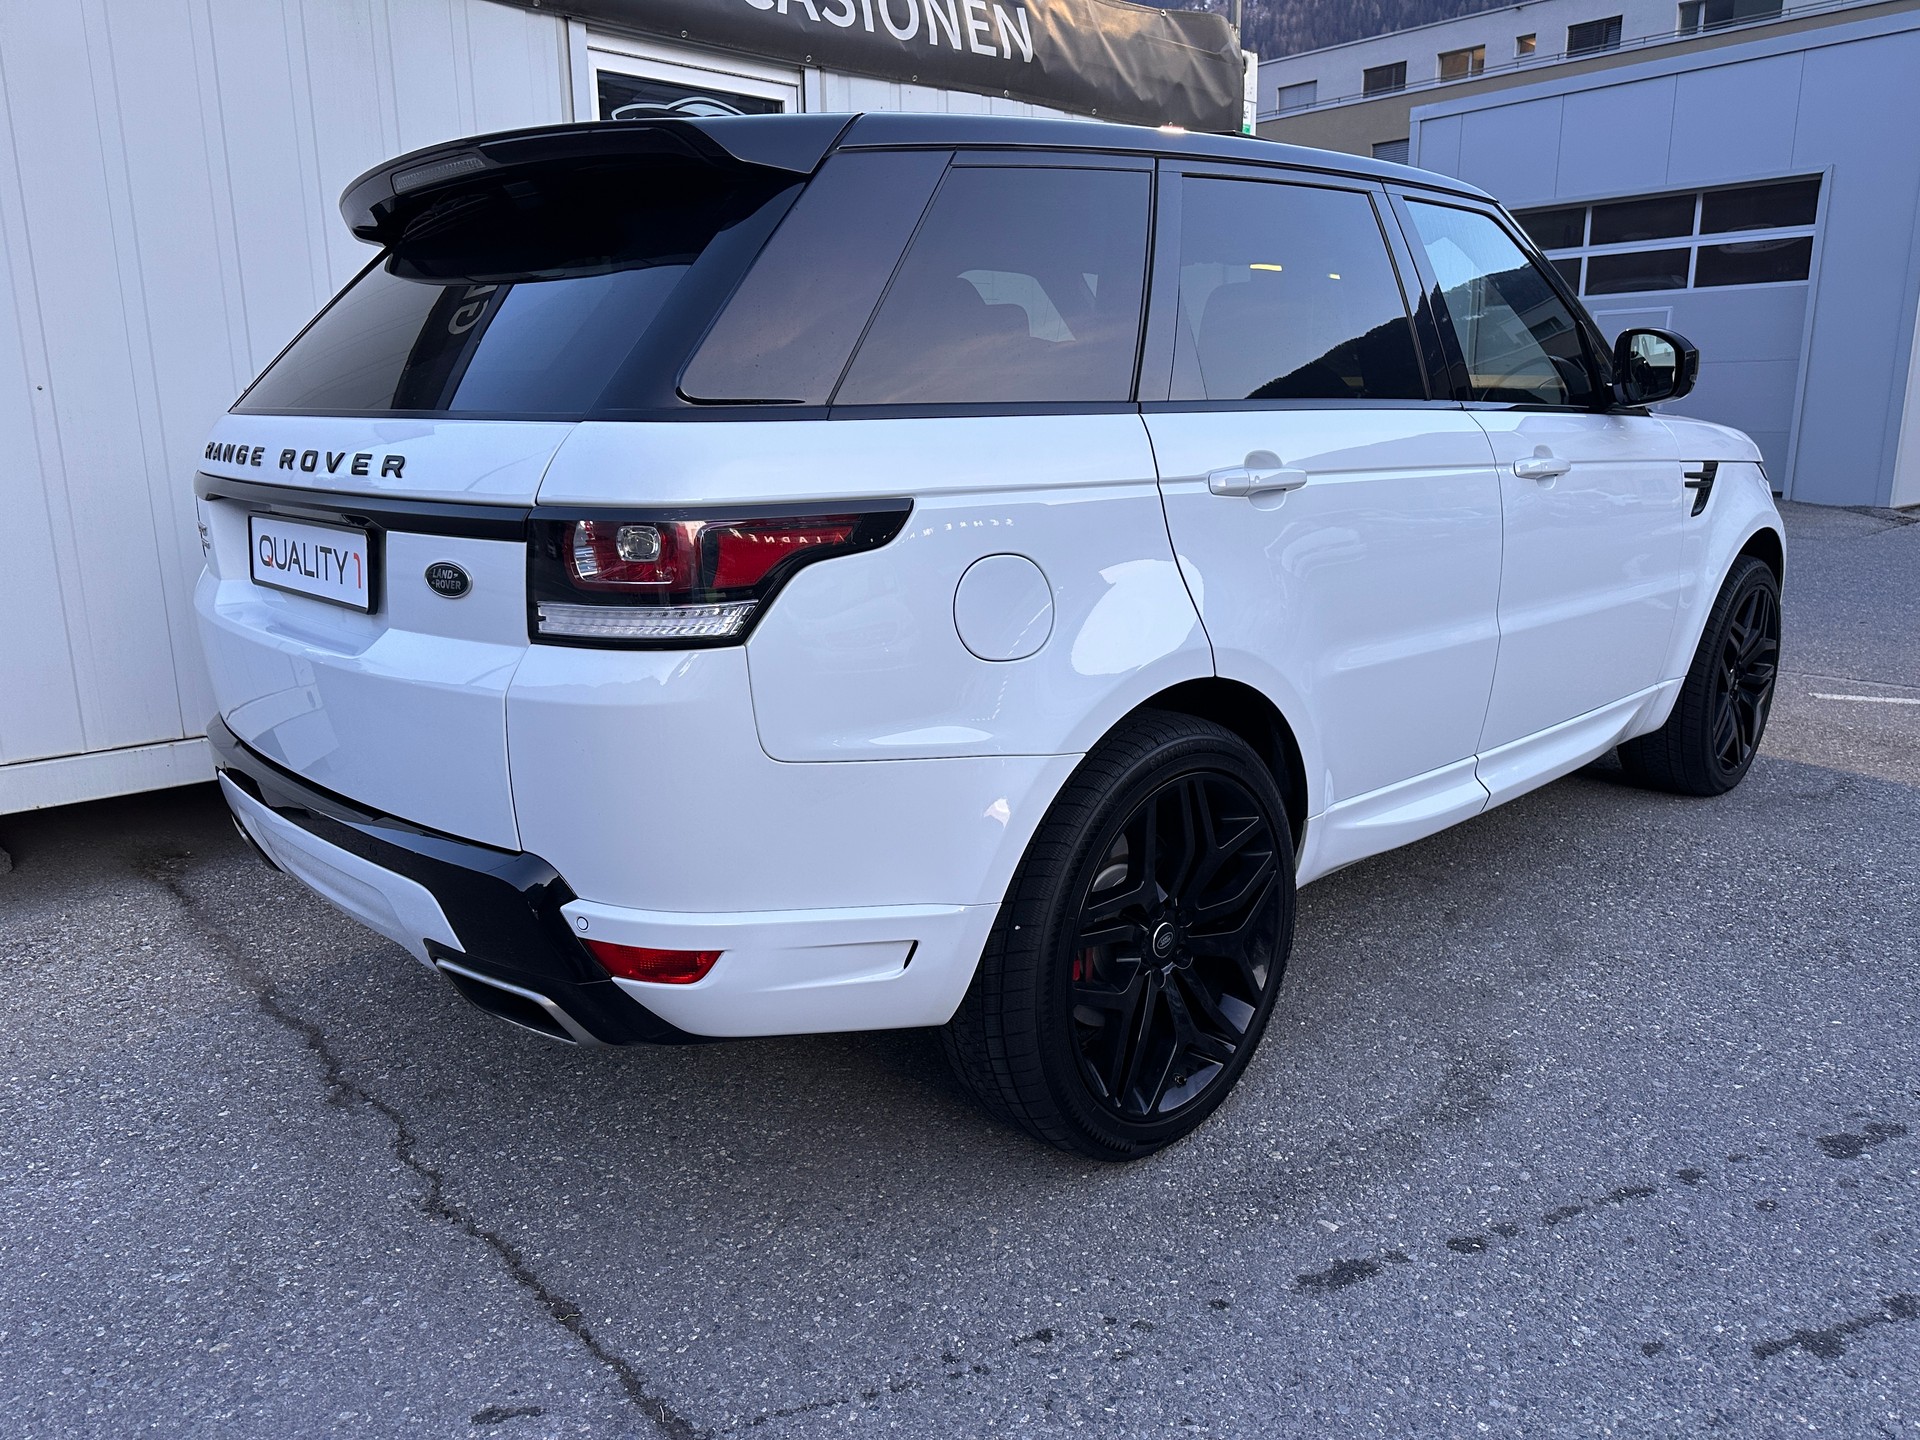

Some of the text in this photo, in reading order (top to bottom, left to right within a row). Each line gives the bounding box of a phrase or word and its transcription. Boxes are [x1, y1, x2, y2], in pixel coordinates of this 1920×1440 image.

[744, 0, 1034, 63] SIONEN
[205, 441, 406, 478] RANGE ROVER
[432, 568, 454, 580] LAND
[435, 579, 462, 590] ROVER
